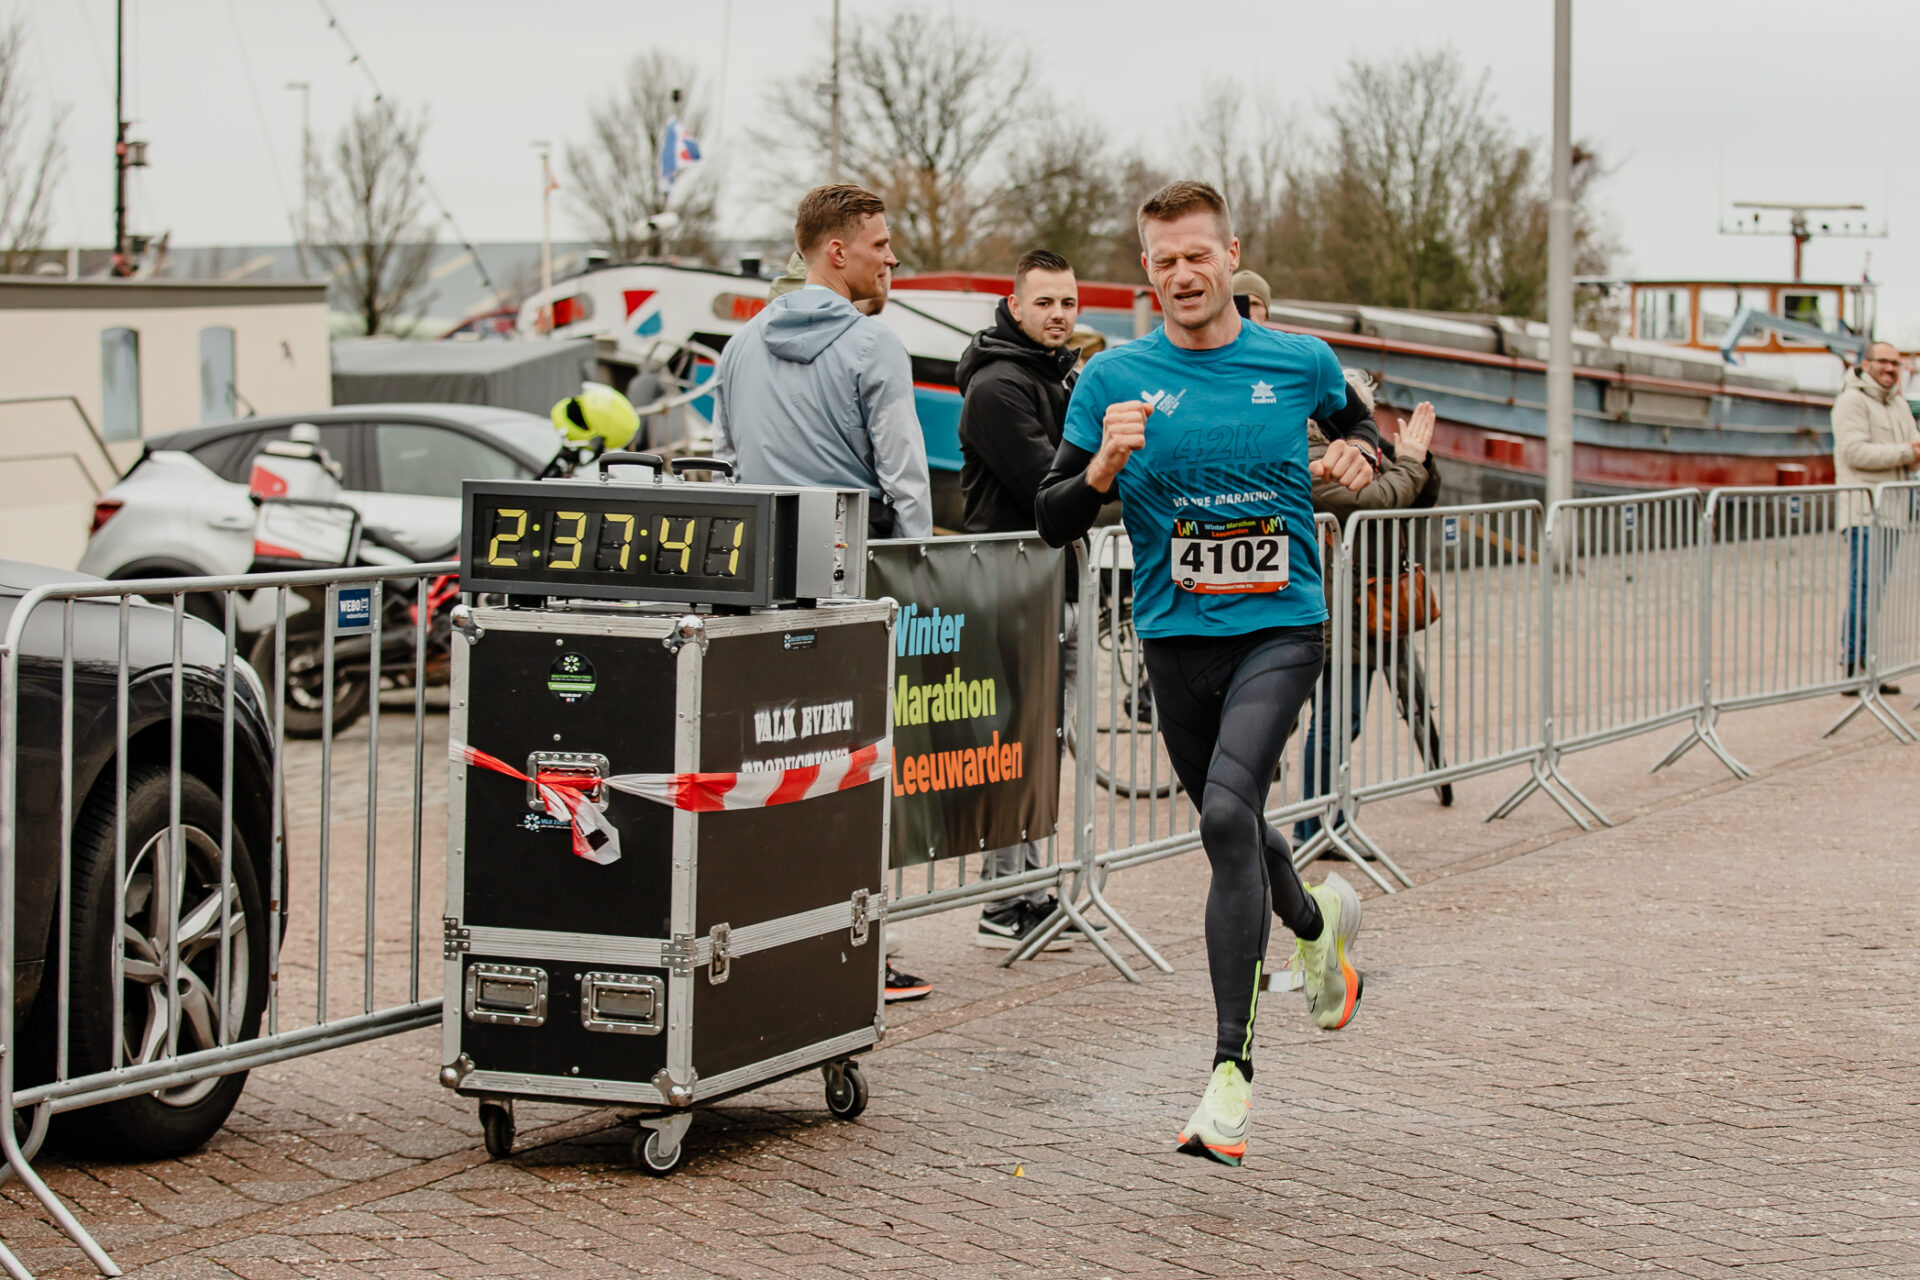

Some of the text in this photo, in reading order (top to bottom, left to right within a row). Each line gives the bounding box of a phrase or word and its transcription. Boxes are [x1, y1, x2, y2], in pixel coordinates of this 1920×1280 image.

[1173, 424, 1266, 464] 42K
[1173, 496, 1189, 508] WE
[1215, 490, 1278, 506] MARATHON
[488, 508, 744, 576] 2:37:41
[1226, 520, 1256, 529] Marathon
[1180, 539, 1279, 575] 4102
[340, 599, 360, 612] WEBO
[893, 667, 997, 727] Marathon
[754, 700, 853, 744] VALK EVENT
[892, 730, 1023, 797] Leeuwarden
